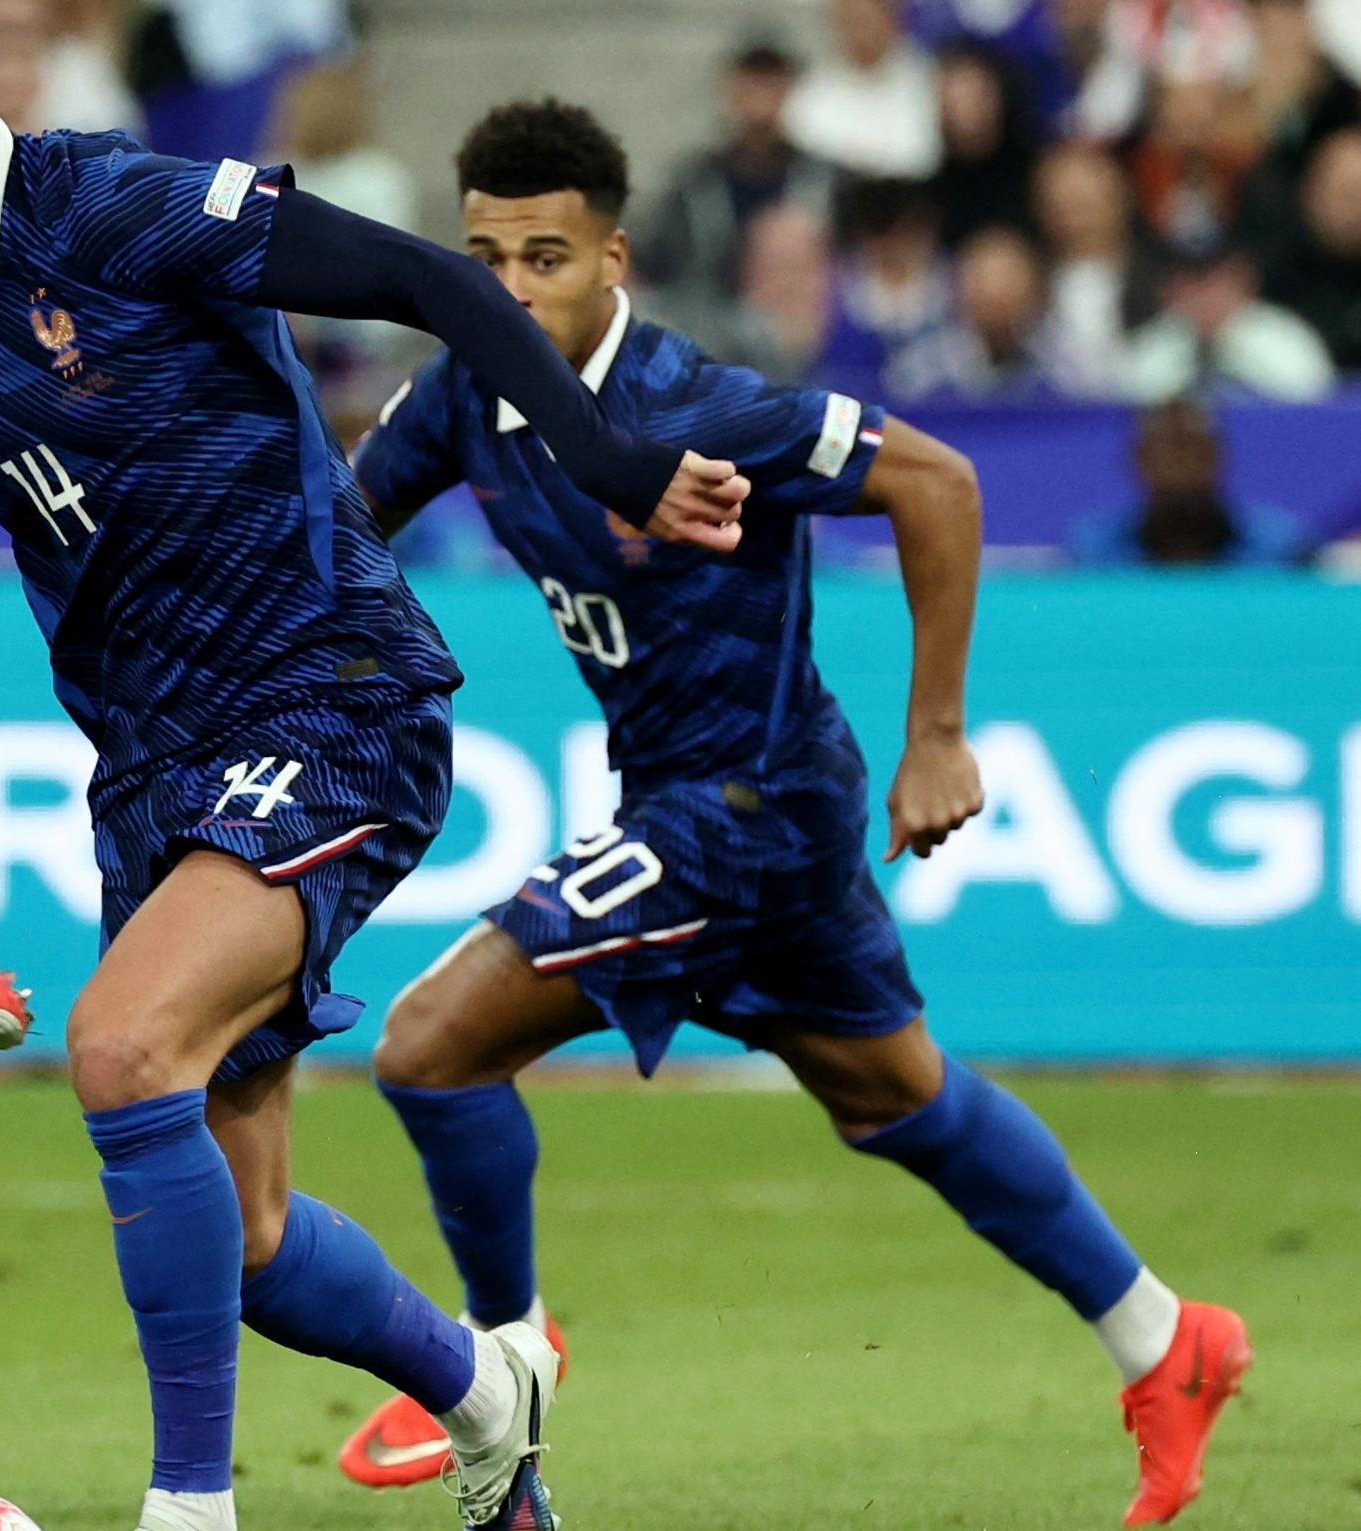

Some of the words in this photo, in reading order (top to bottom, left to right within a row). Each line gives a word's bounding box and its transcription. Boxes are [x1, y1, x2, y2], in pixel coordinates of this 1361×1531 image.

[0, 443, 97, 547] 14
[540, 576, 630, 669] 20
[213, 756, 303, 819] 14
